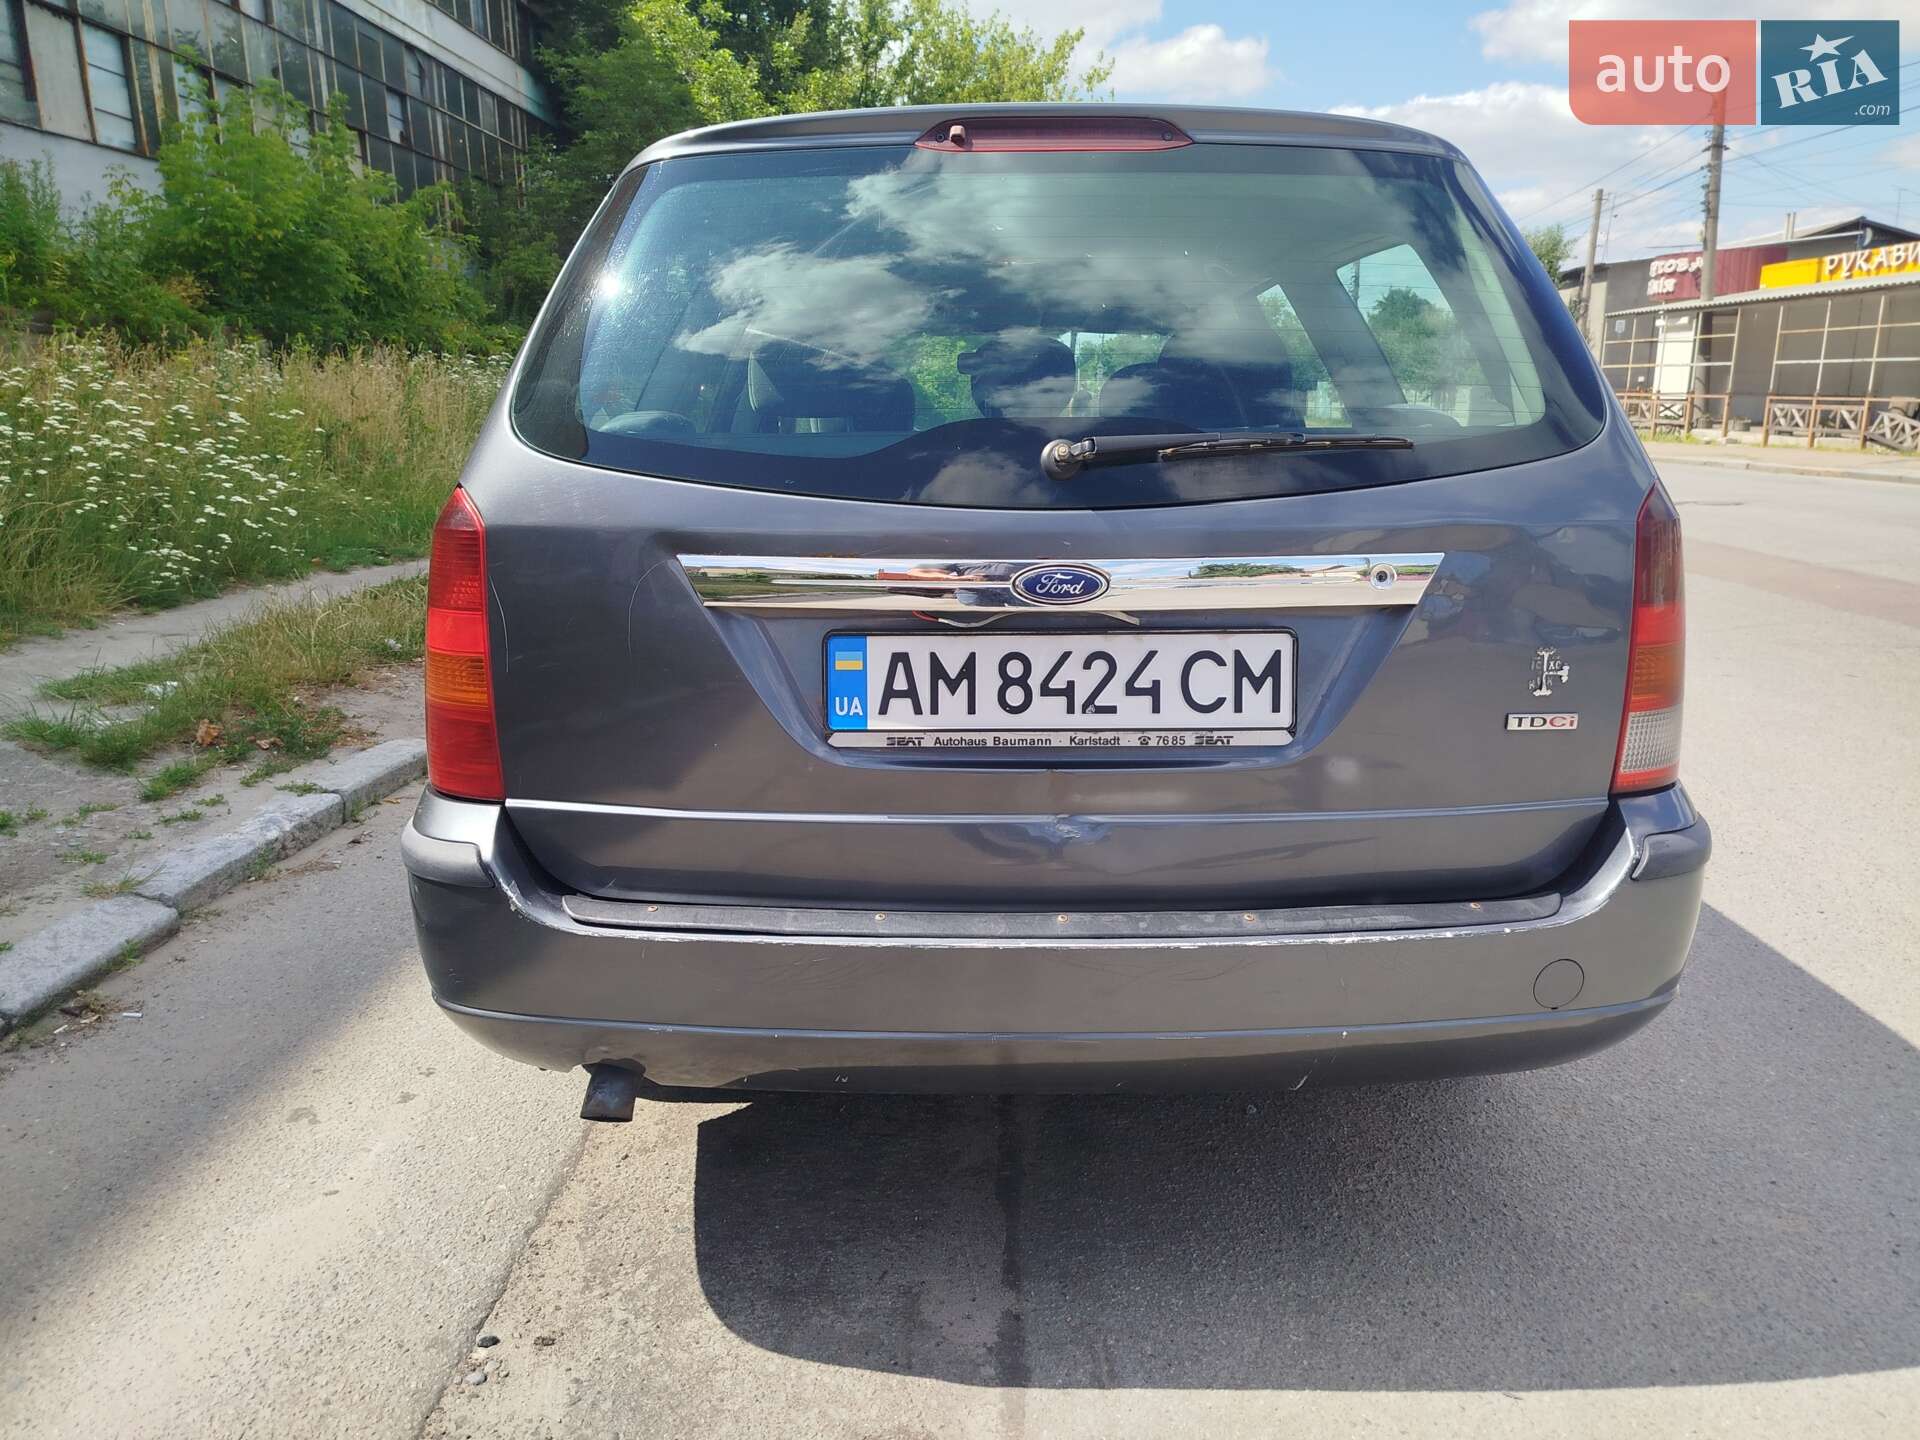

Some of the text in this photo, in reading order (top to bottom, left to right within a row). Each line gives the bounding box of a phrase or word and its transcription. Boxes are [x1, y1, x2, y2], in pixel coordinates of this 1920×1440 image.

[1036, 573, 1085, 594] Ford
[878, 649, 1282, 716] AM 8424 CM
[835, 696, 863, 716] UA
[1512, 716, 1576, 728] TDCi
[886, 737, 924, 746] SEAT
[934, 736, 987, 746] Autohaus
[993, 736, 1052, 746] Baumann
[1069, 735, 1121, 746] Karlstadt
[1195, 735, 1234, 745] SEAT
